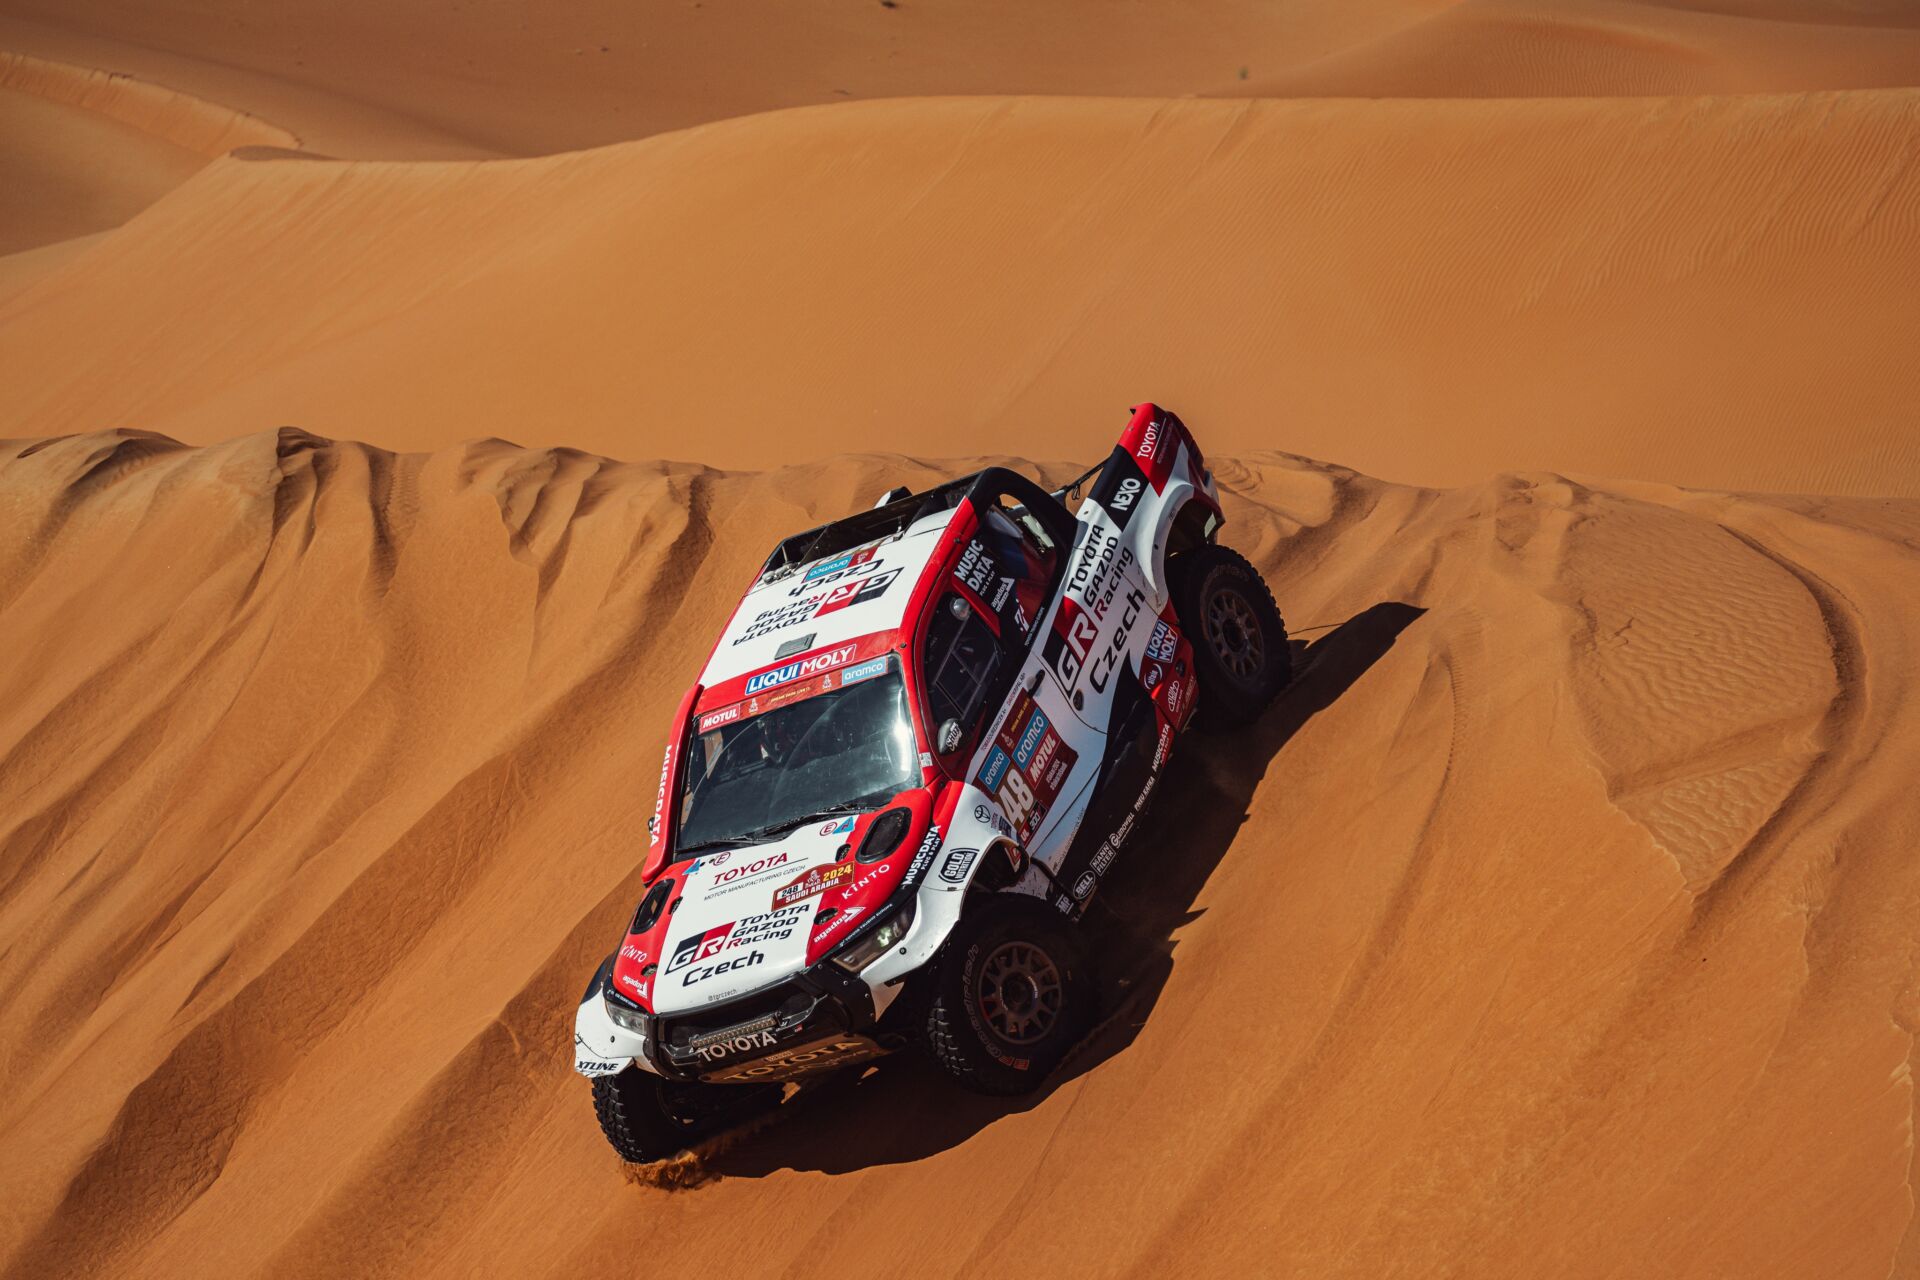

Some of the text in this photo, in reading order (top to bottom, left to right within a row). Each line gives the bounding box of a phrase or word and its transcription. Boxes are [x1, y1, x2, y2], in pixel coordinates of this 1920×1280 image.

[1137, 421, 1160, 458] TOYOTA
[1110, 478, 1140, 511] NEXO
[954, 540, 984, 581] MUSIC
[967, 556, 994, 592] DATA
[1067, 524, 1104, 592] TOYOTA
[1084, 536, 1118, 607] GAZOO
[788, 559, 885, 597] Czech
[990, 582, 1006, 607] agados
[1093, 547, 1134, 621] Racing
[746, 603, 819, 633] GAZOO
[756, 592, 826, 622] Racing
[732, 614, 809, 647] TOYOTA
[1090, 588, 1146, 694] Czech
[1146, 620, 1168, 657] LIQUI
[1160, 629, 1176, 662] MOLY
[1051, 605, 1099, 699] GR
[748, 647, 851, 692] LIQUI MOLY
[845, 662, 883, 680] aramco
[703, 707, 738, 728] MOTUL
[1017, 716, 1044, 764] aramco
[1152, 724, 1170, 772] MUSICDATA
[986, 752, 1005, 785] aramco
[1030, 734, 1056, 783] MOTUL
[650, 745, 672, 847] MUSICDATA
[714, 852, 787, 885] TOYOTA
[906, 825, 942, 885] MUSICDATA
[922, 858, 930, 870] PLUG
[931, 837, 941, 851] PLAY
[944, 853, 965, 877] GOLD
[956, 852, 974, 879] NUTRITION
[1092, 844, 1109, 867] MANN
[1096, 849, 1113, 872] FILTER
[704, 865, 806, 900] MOTOR MANUFACTURING CZECH
[823, 864, 852, 882] 2024
[1075, 874, 1093, 895] BELL
[782, 885, 799, 898] 248
[785, 878, 839, 903] SAUDI ARABIA
[732, 916, 799, 938] GAZOO
[740, 904, 810, 926] TOYOTA
[813, 912, 849, 944] agados
[665, 928, 732, 975] GR
[726, 928, 792, 950] Racing
[682, 950, 765, 987] Czech
[698, 1032, 777, 1063] TOYOTA
[724, 1042, 864, 1081] TOYOTA
